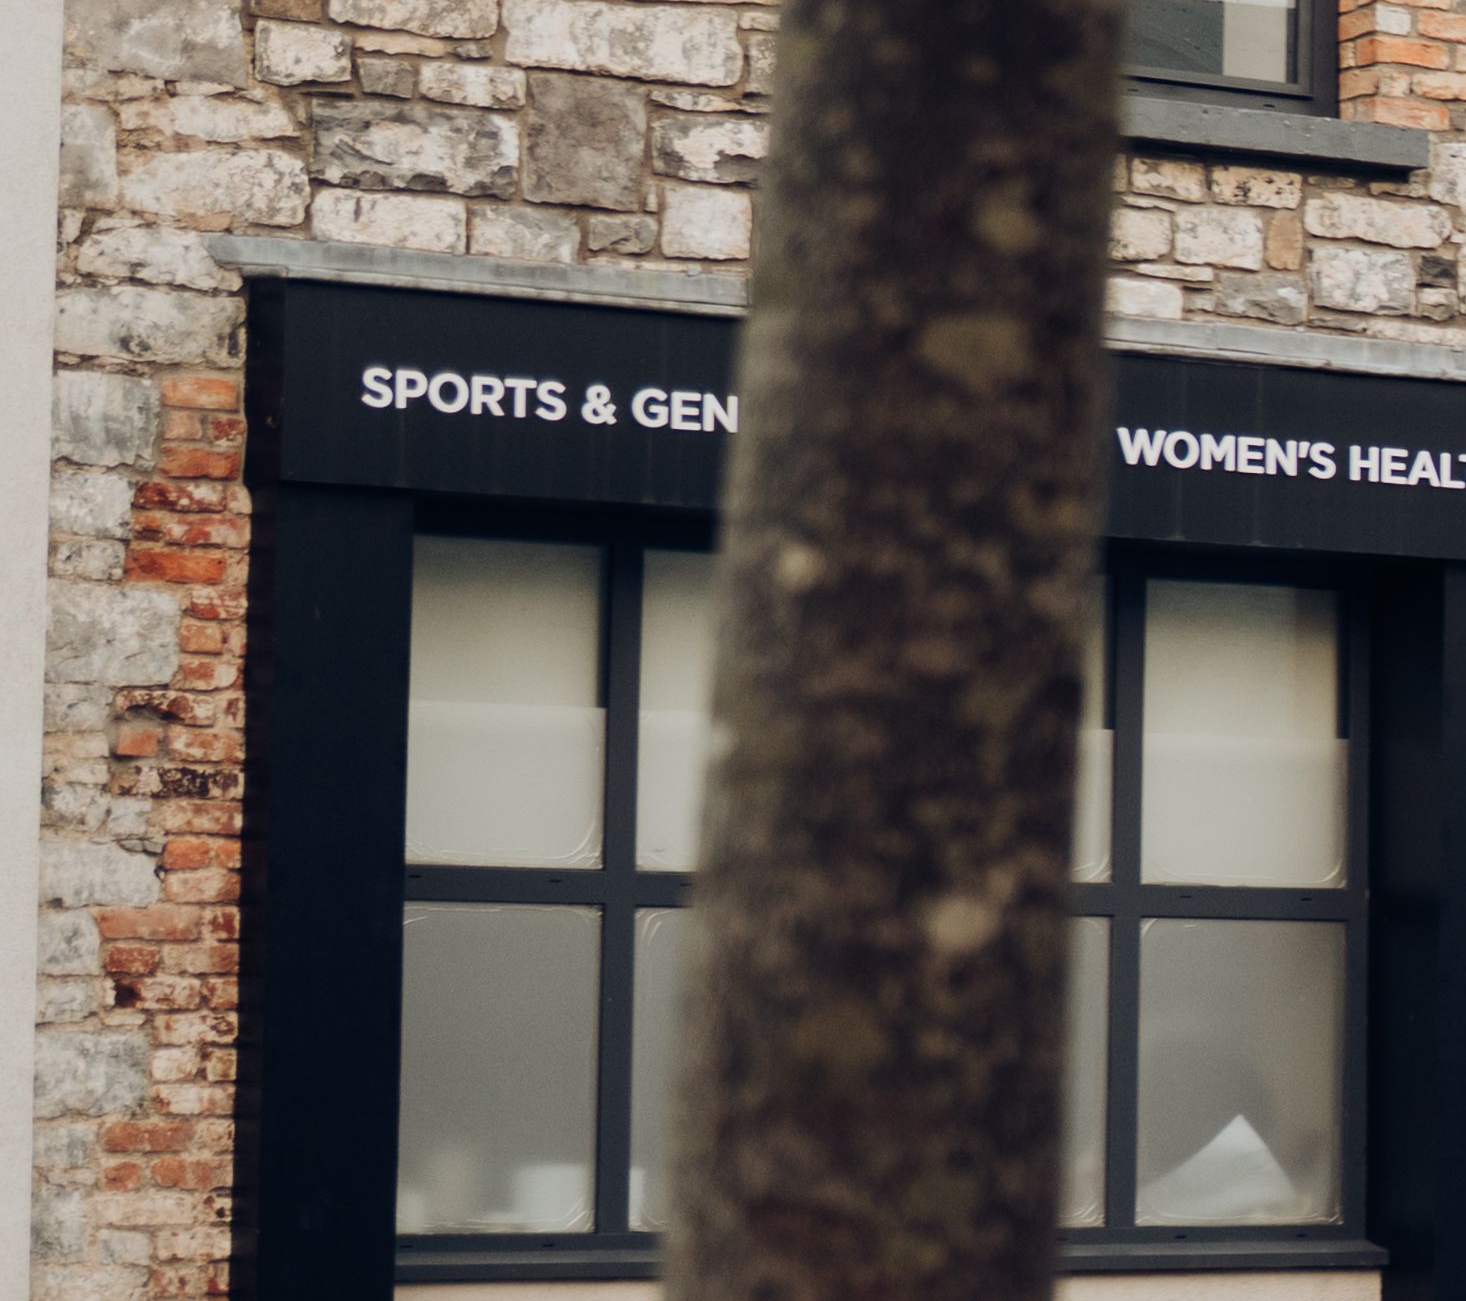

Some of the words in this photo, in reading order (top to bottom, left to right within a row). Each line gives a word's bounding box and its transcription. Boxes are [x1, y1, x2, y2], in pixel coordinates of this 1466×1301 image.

[361, 366, 568, 421] SPORTS
[580, 384, 617, 425] &
[631, 387, 739, 434] GEN
[1116, 426, 1337, 480] WOMEN'S
